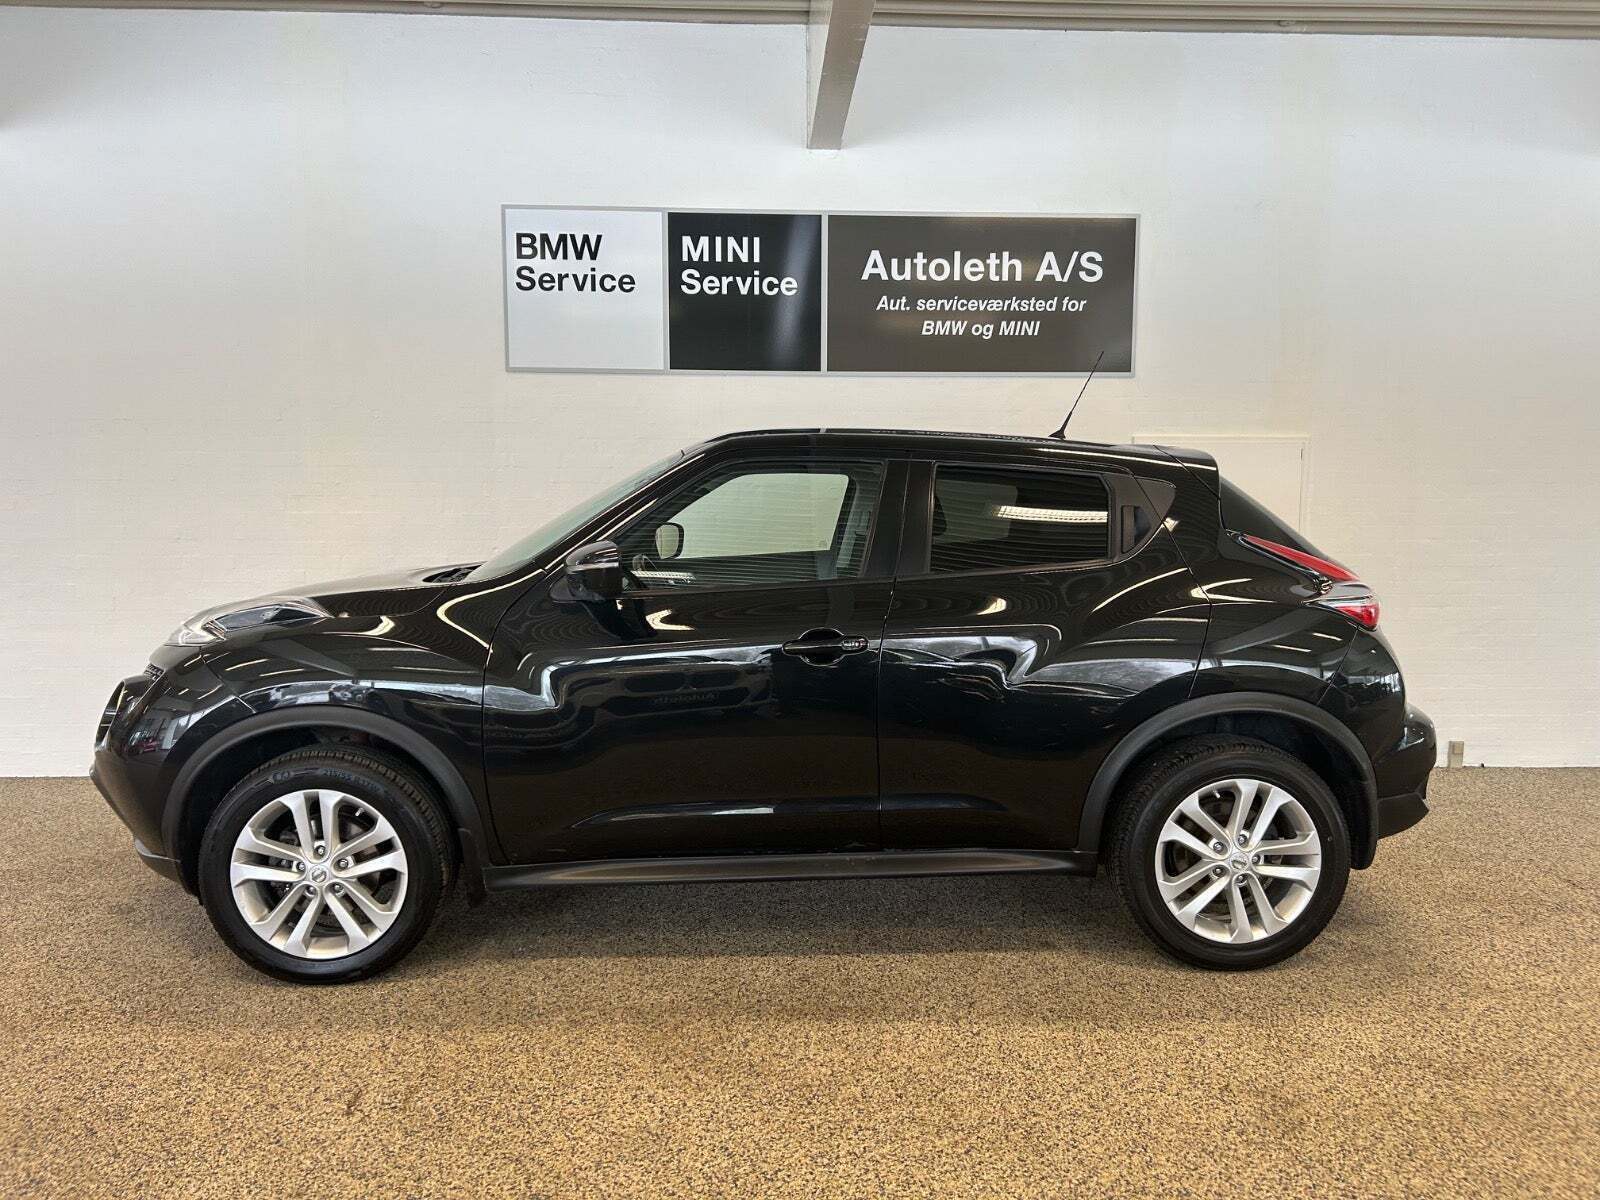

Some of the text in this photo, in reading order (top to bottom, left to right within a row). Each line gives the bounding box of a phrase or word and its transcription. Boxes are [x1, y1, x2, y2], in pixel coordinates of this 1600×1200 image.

[515, 232, 603, 261] BMW
[682, 235, 761, 263] MINI
[515, 265, 636, 293] Service
[860, 248, 1105, 284] Autoleth A/S
[680, 268, 799, 296] Service
[875, 295, 1087, 313] Aut. serviceværksted for
[921, 319, 1041, 340] BMW og MINI
